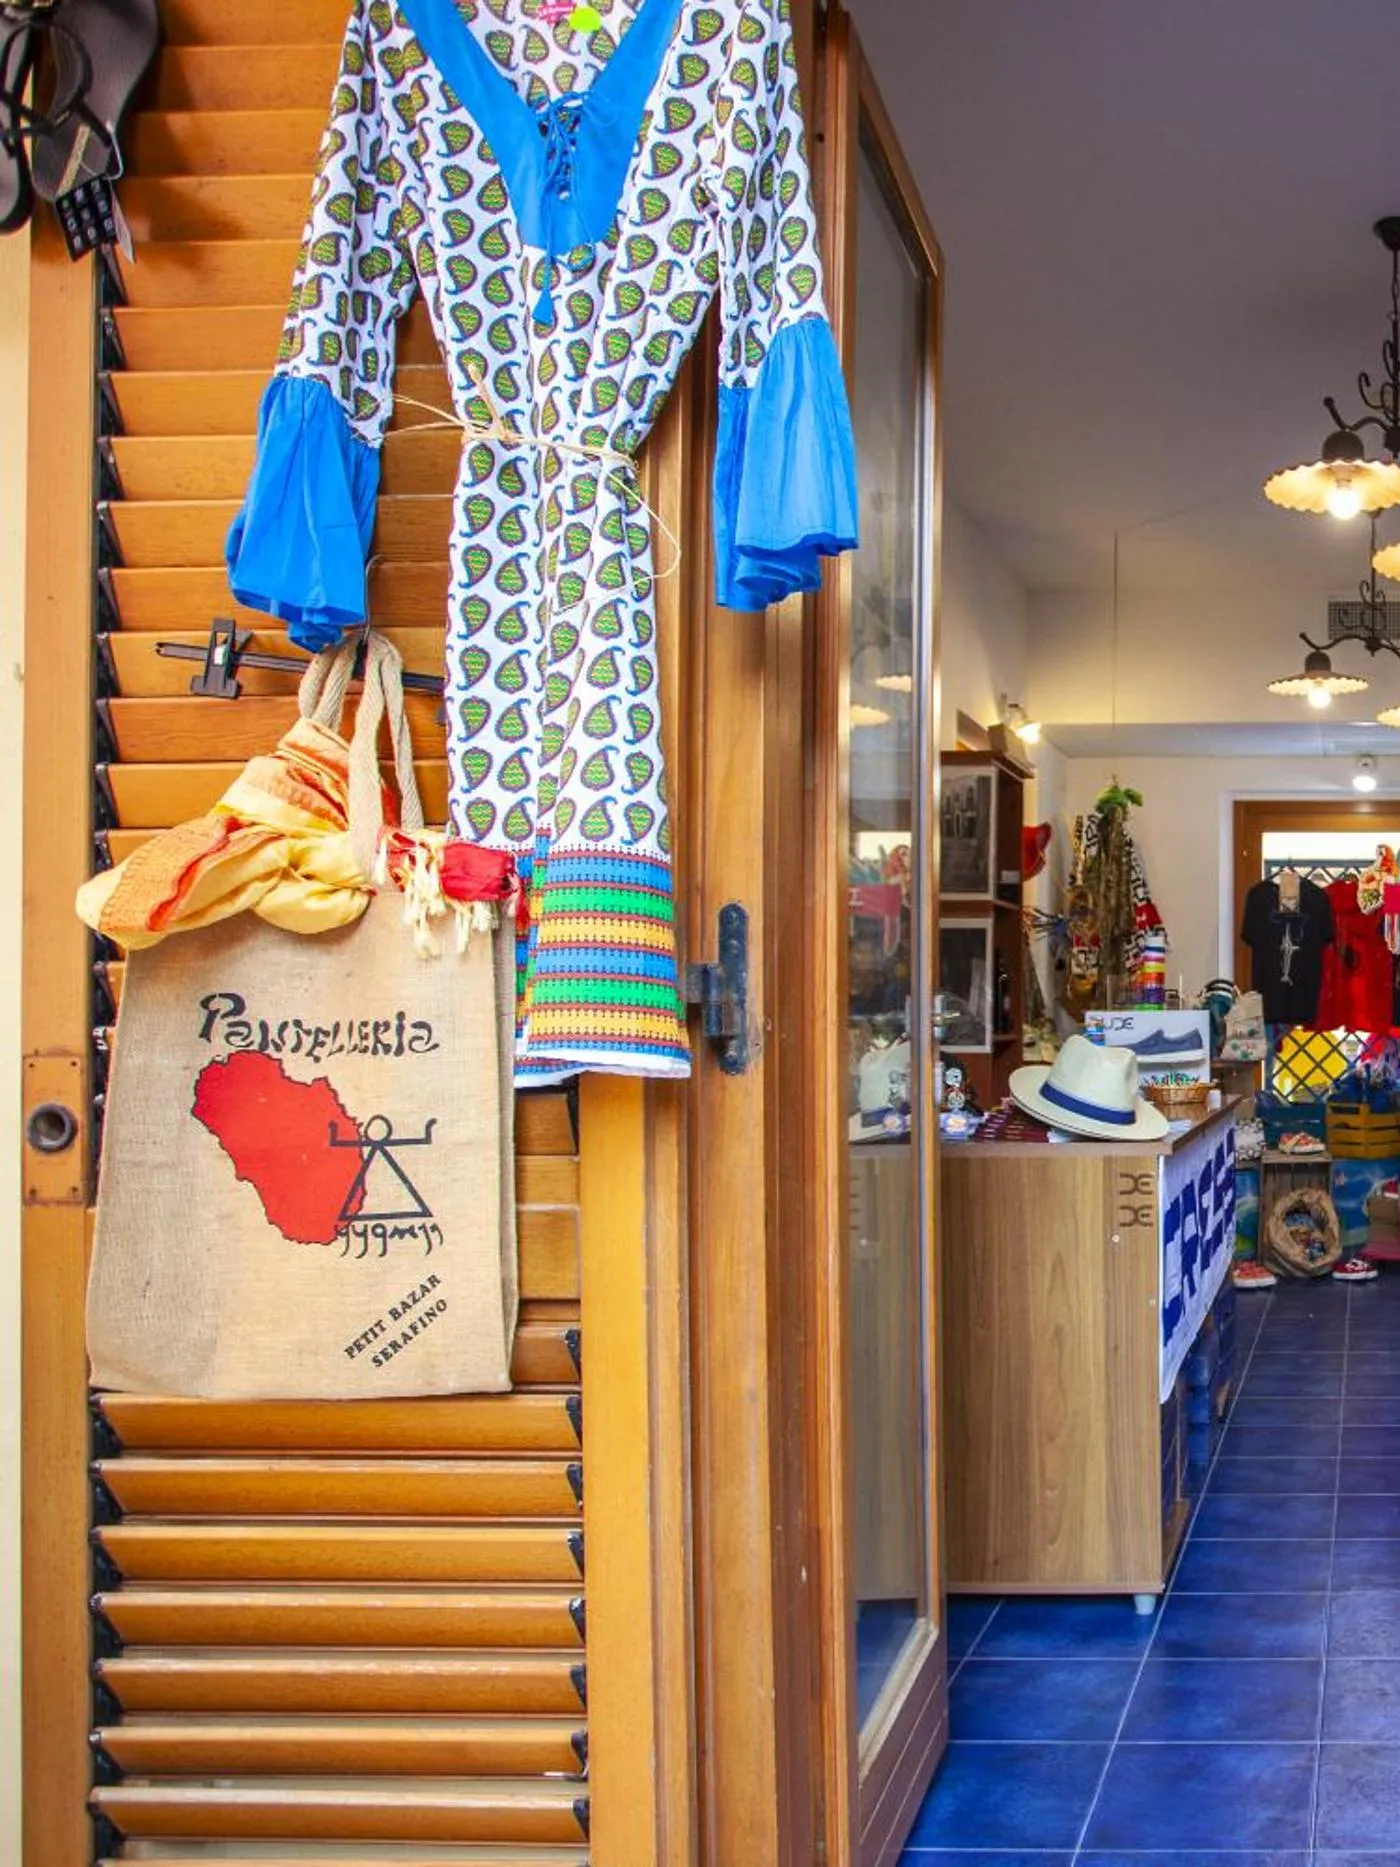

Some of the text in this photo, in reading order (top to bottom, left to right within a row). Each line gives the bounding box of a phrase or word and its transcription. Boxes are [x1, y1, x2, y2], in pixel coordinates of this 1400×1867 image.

[343, 1274, 442, 1359] PETIT BAZAR
[371, 1298, 447, 1368] SERAFINO
